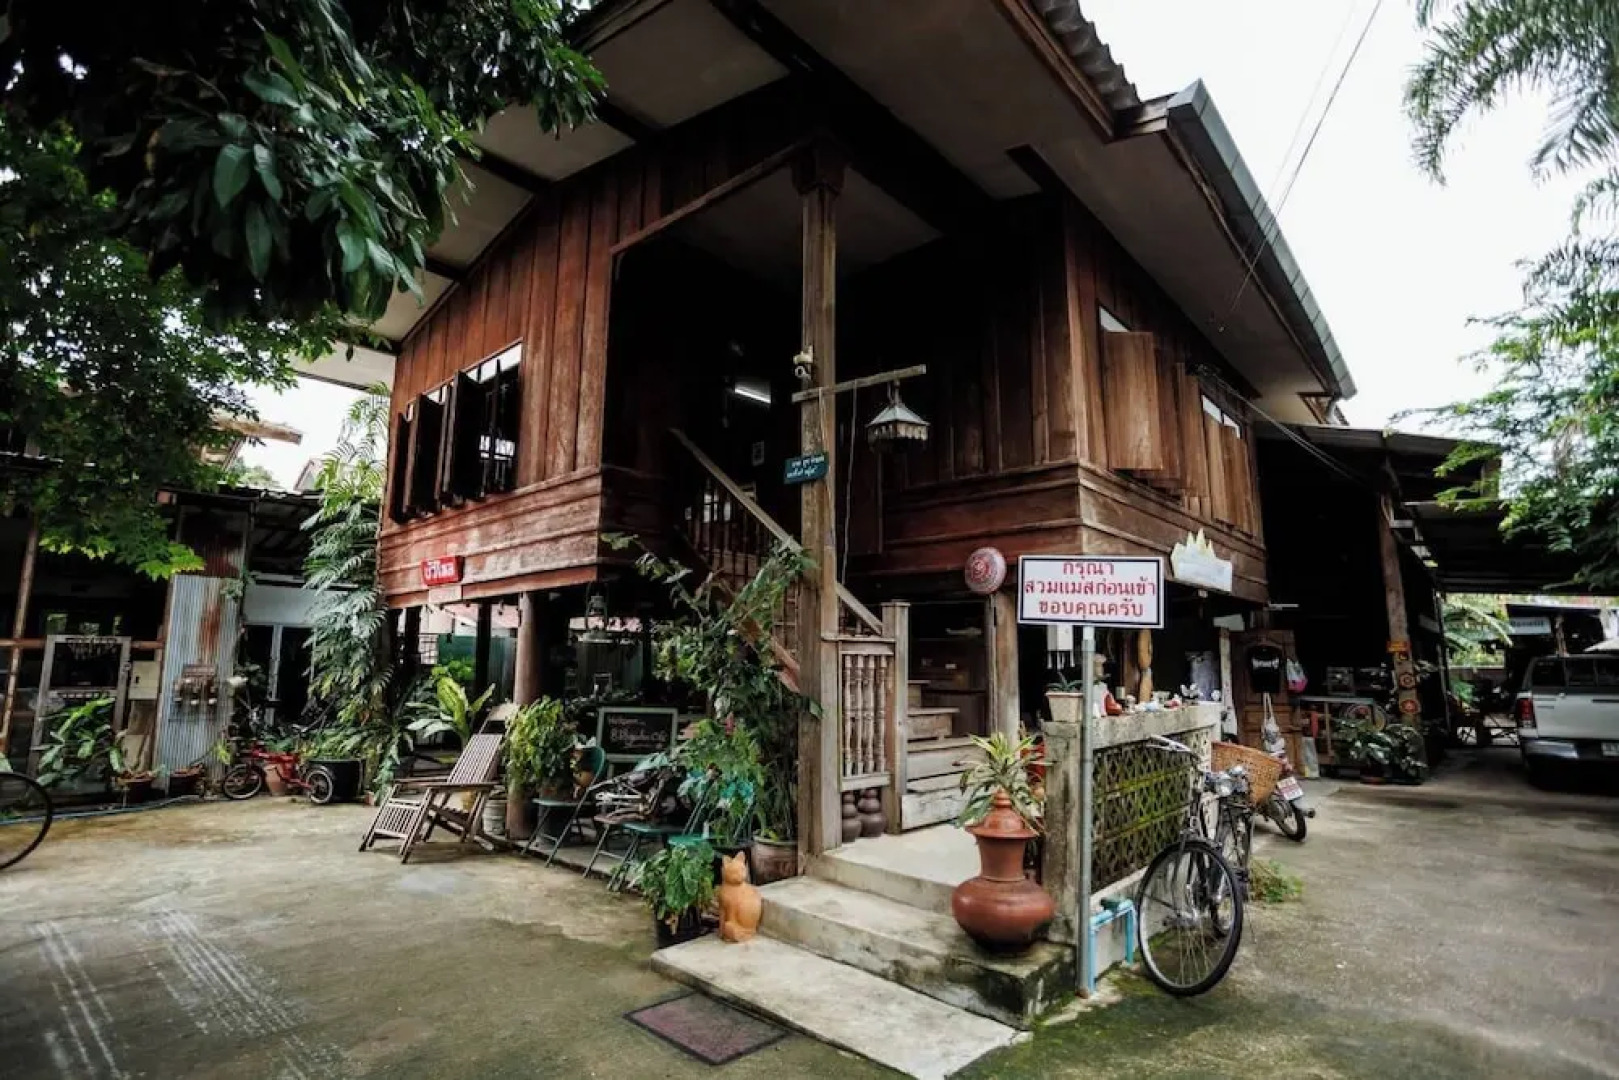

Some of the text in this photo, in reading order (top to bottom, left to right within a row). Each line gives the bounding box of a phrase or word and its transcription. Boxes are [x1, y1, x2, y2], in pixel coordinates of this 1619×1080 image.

[1063, 561, 1114, 579] กรุณา
[1025, 576, 1156, 596] สวมแมสก่อนเข้า
[1039, 598, 1143, 619] ขอบคุณครับ
